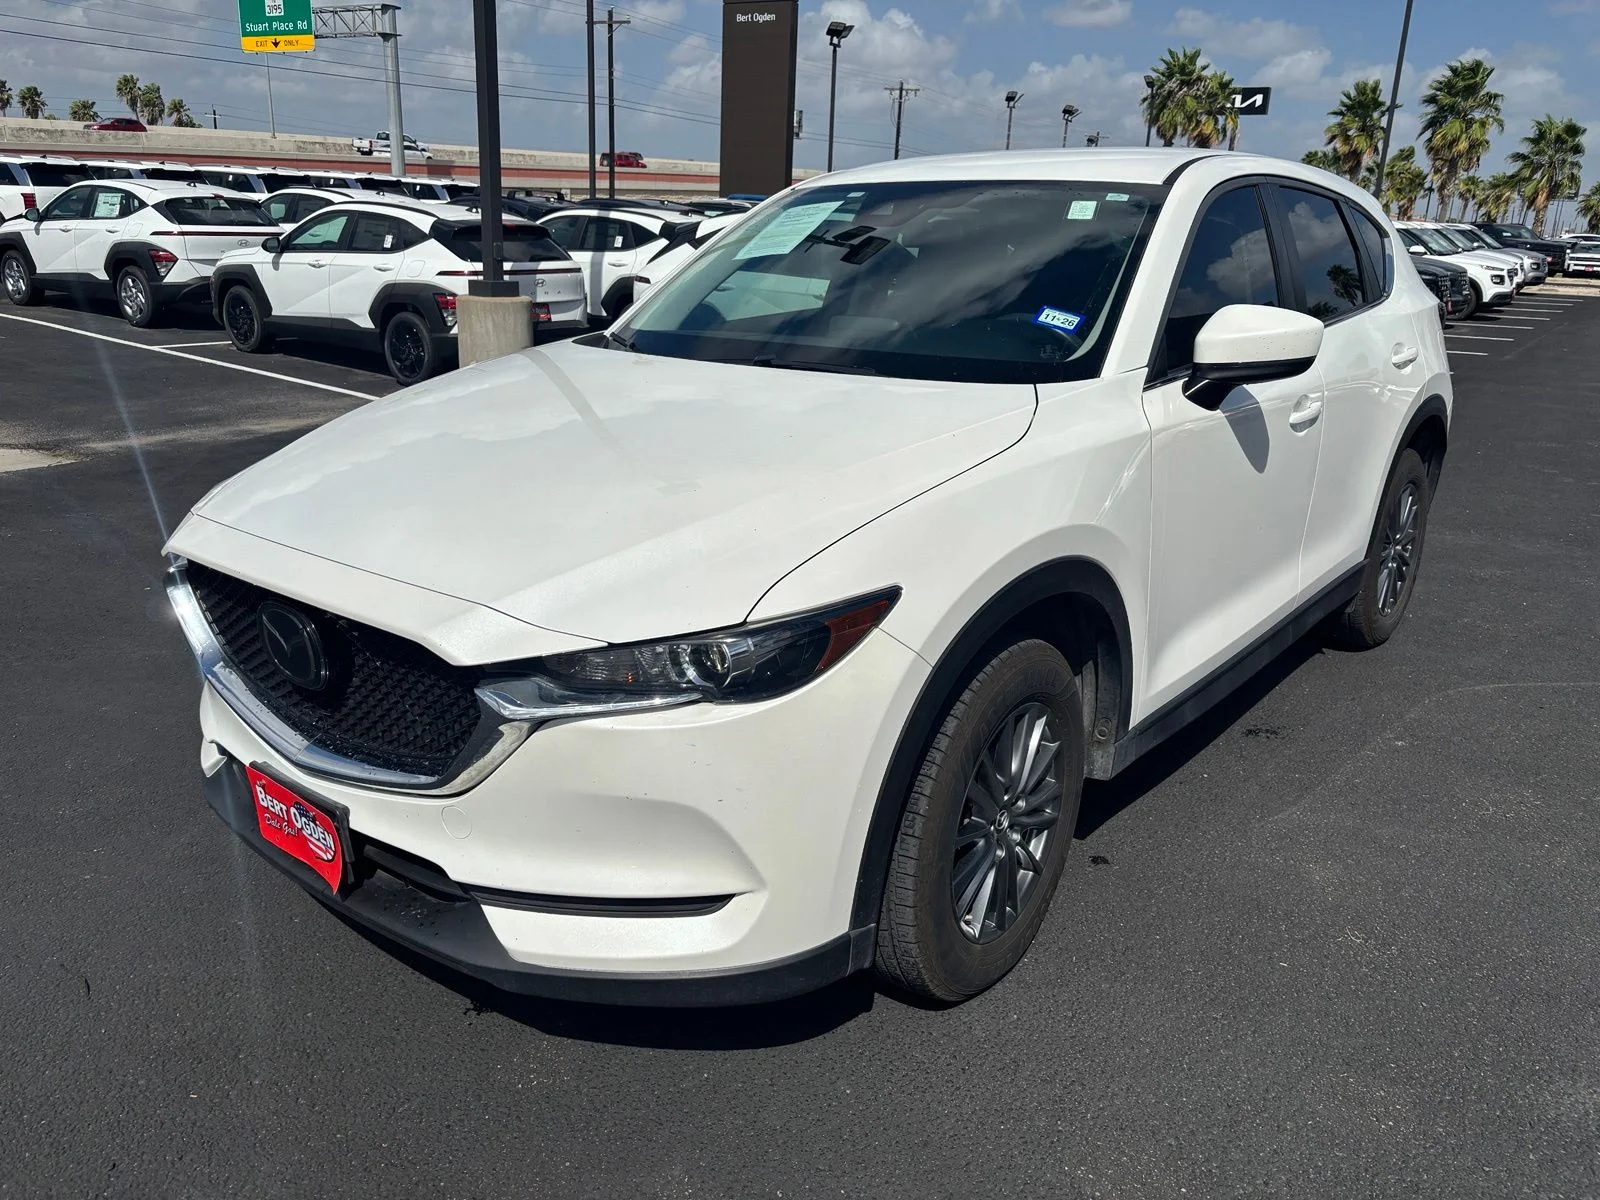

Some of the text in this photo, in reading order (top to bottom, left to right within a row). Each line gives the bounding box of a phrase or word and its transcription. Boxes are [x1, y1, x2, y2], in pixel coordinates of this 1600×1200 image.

[266, 4, 282, 15] 3195
[736, 12, 776, 23] Bert Ogden
[246, 20, 308, 32] Stuart Place Rd
[255, 784, 336, 851] BERT OGDEN
